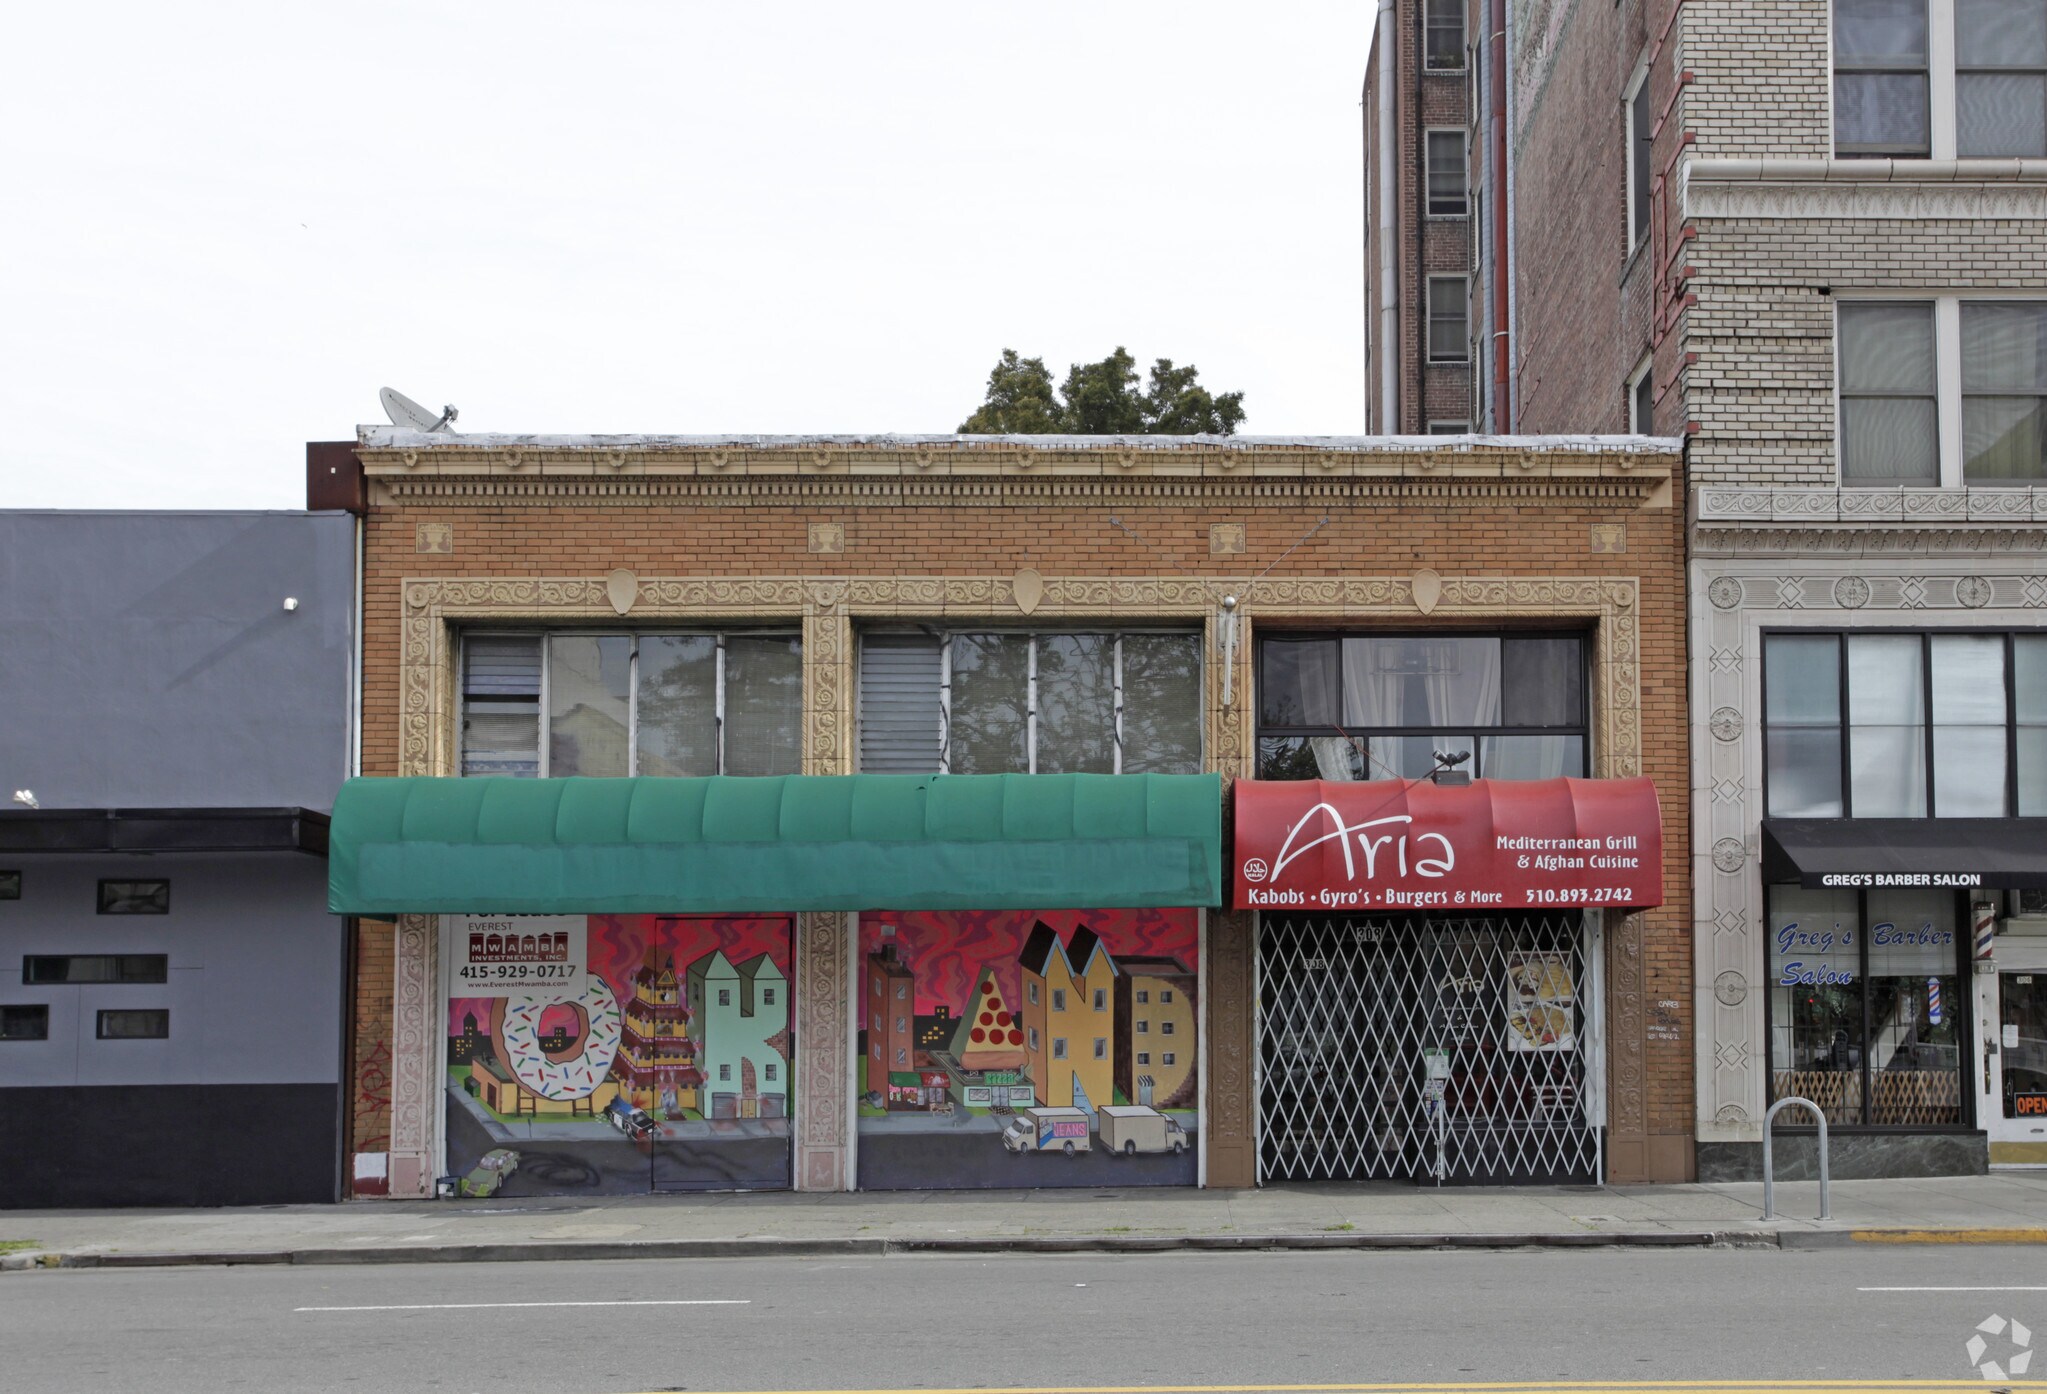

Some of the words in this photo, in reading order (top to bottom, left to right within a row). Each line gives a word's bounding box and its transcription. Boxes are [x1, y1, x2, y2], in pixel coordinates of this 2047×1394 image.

[1270, 802, 1455, 883] Aria
[1496, 836, 1601, 849] Mediterranean
[1606, 836, 1637, 849] Grill
[1517, 855, 1530, 868] &
[1534, 855, 1584, 871] Afghan
[1589, 855, 1639, 868] Cuisine
[1822, 874, 1873, 886] GREG'S
[1875, 874, 1931, 886] BARBER
[1933, 874, 1981, 886] SALON
[1248, 888, 1305, 904] Kabobs
[1320, 888, 1370, 907] Gyro's
[1386, 888, 1448, 906] Burgers
[1454, 891, 1466, 903] &
[1470, 891, 1502, 903] More
[1526, 888, 1632, 902] 510.893.2742
[468, 922, 513, 931] EVEREST
[1777, 922, 1853, 954] Greg's
[1873, 922, 1953, 946] Barber
[471, 943, 566, 953] MWAMBA
[460, 965, 576, 978] 415-929-0717
[1780, 961, 1852, 985] Salon
[1053, 1122, 1086, 1137] JEANS
